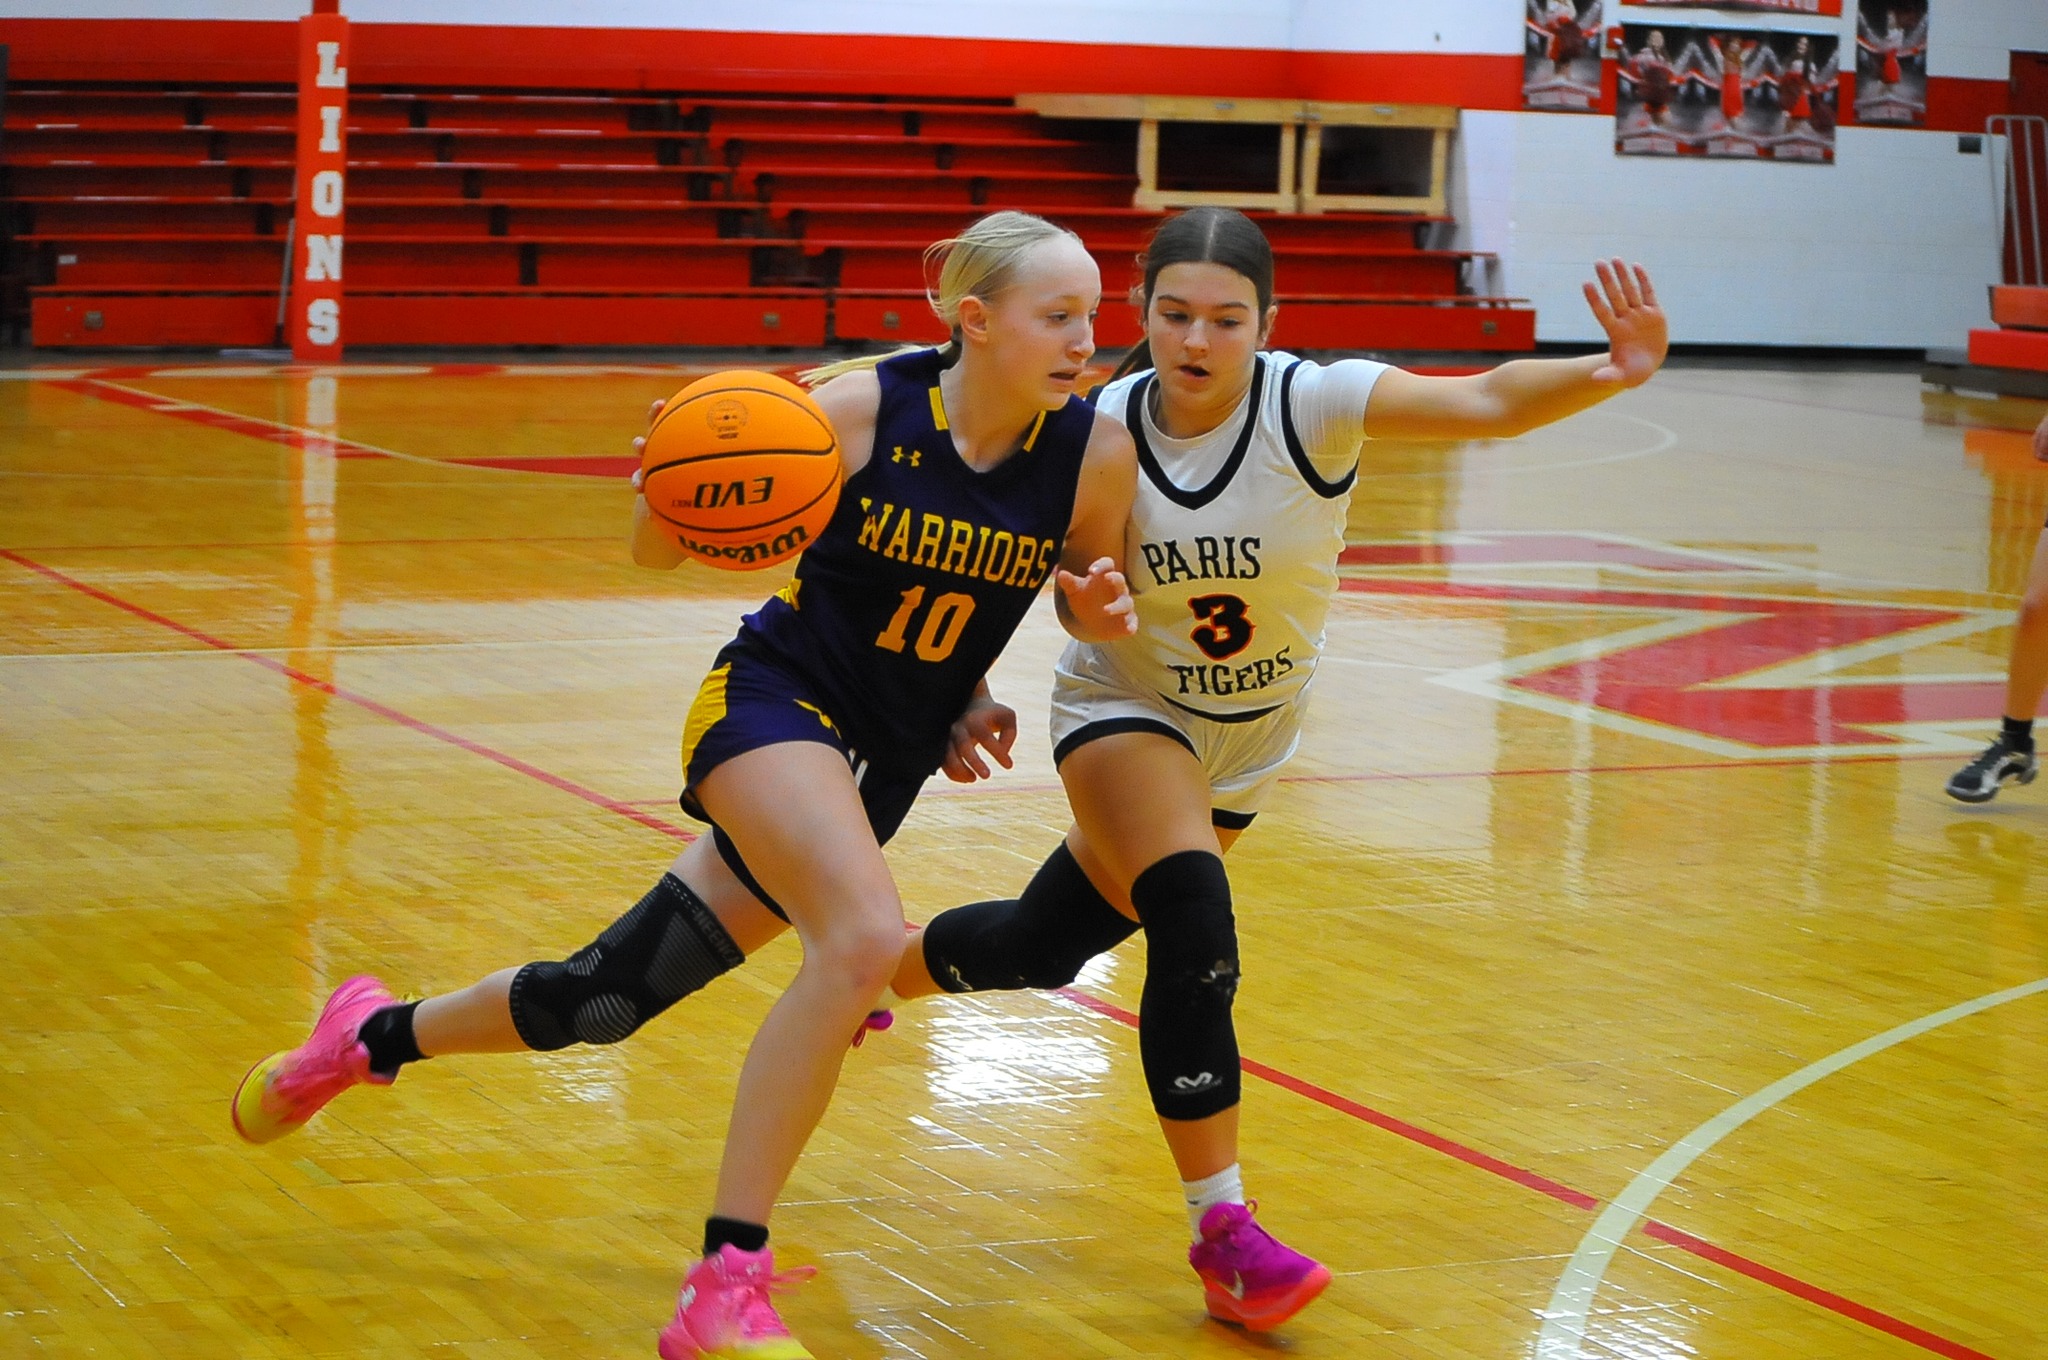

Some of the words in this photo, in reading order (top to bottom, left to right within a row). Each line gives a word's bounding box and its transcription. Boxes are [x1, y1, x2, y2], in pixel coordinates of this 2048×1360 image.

[305, 41, 348, 346] LIONS
[693, 476, 774, 509] EVO
[677, 524, 809, 564] Wilson
[857, 496, 1054, 589] WARRIORS
[1140, 536, 1261, 586] PARIS
[875, 584, 976, 663] 10
[1187, 592, 1256, 662] 3
[1166, 645, 1294, 696] TIGERS
